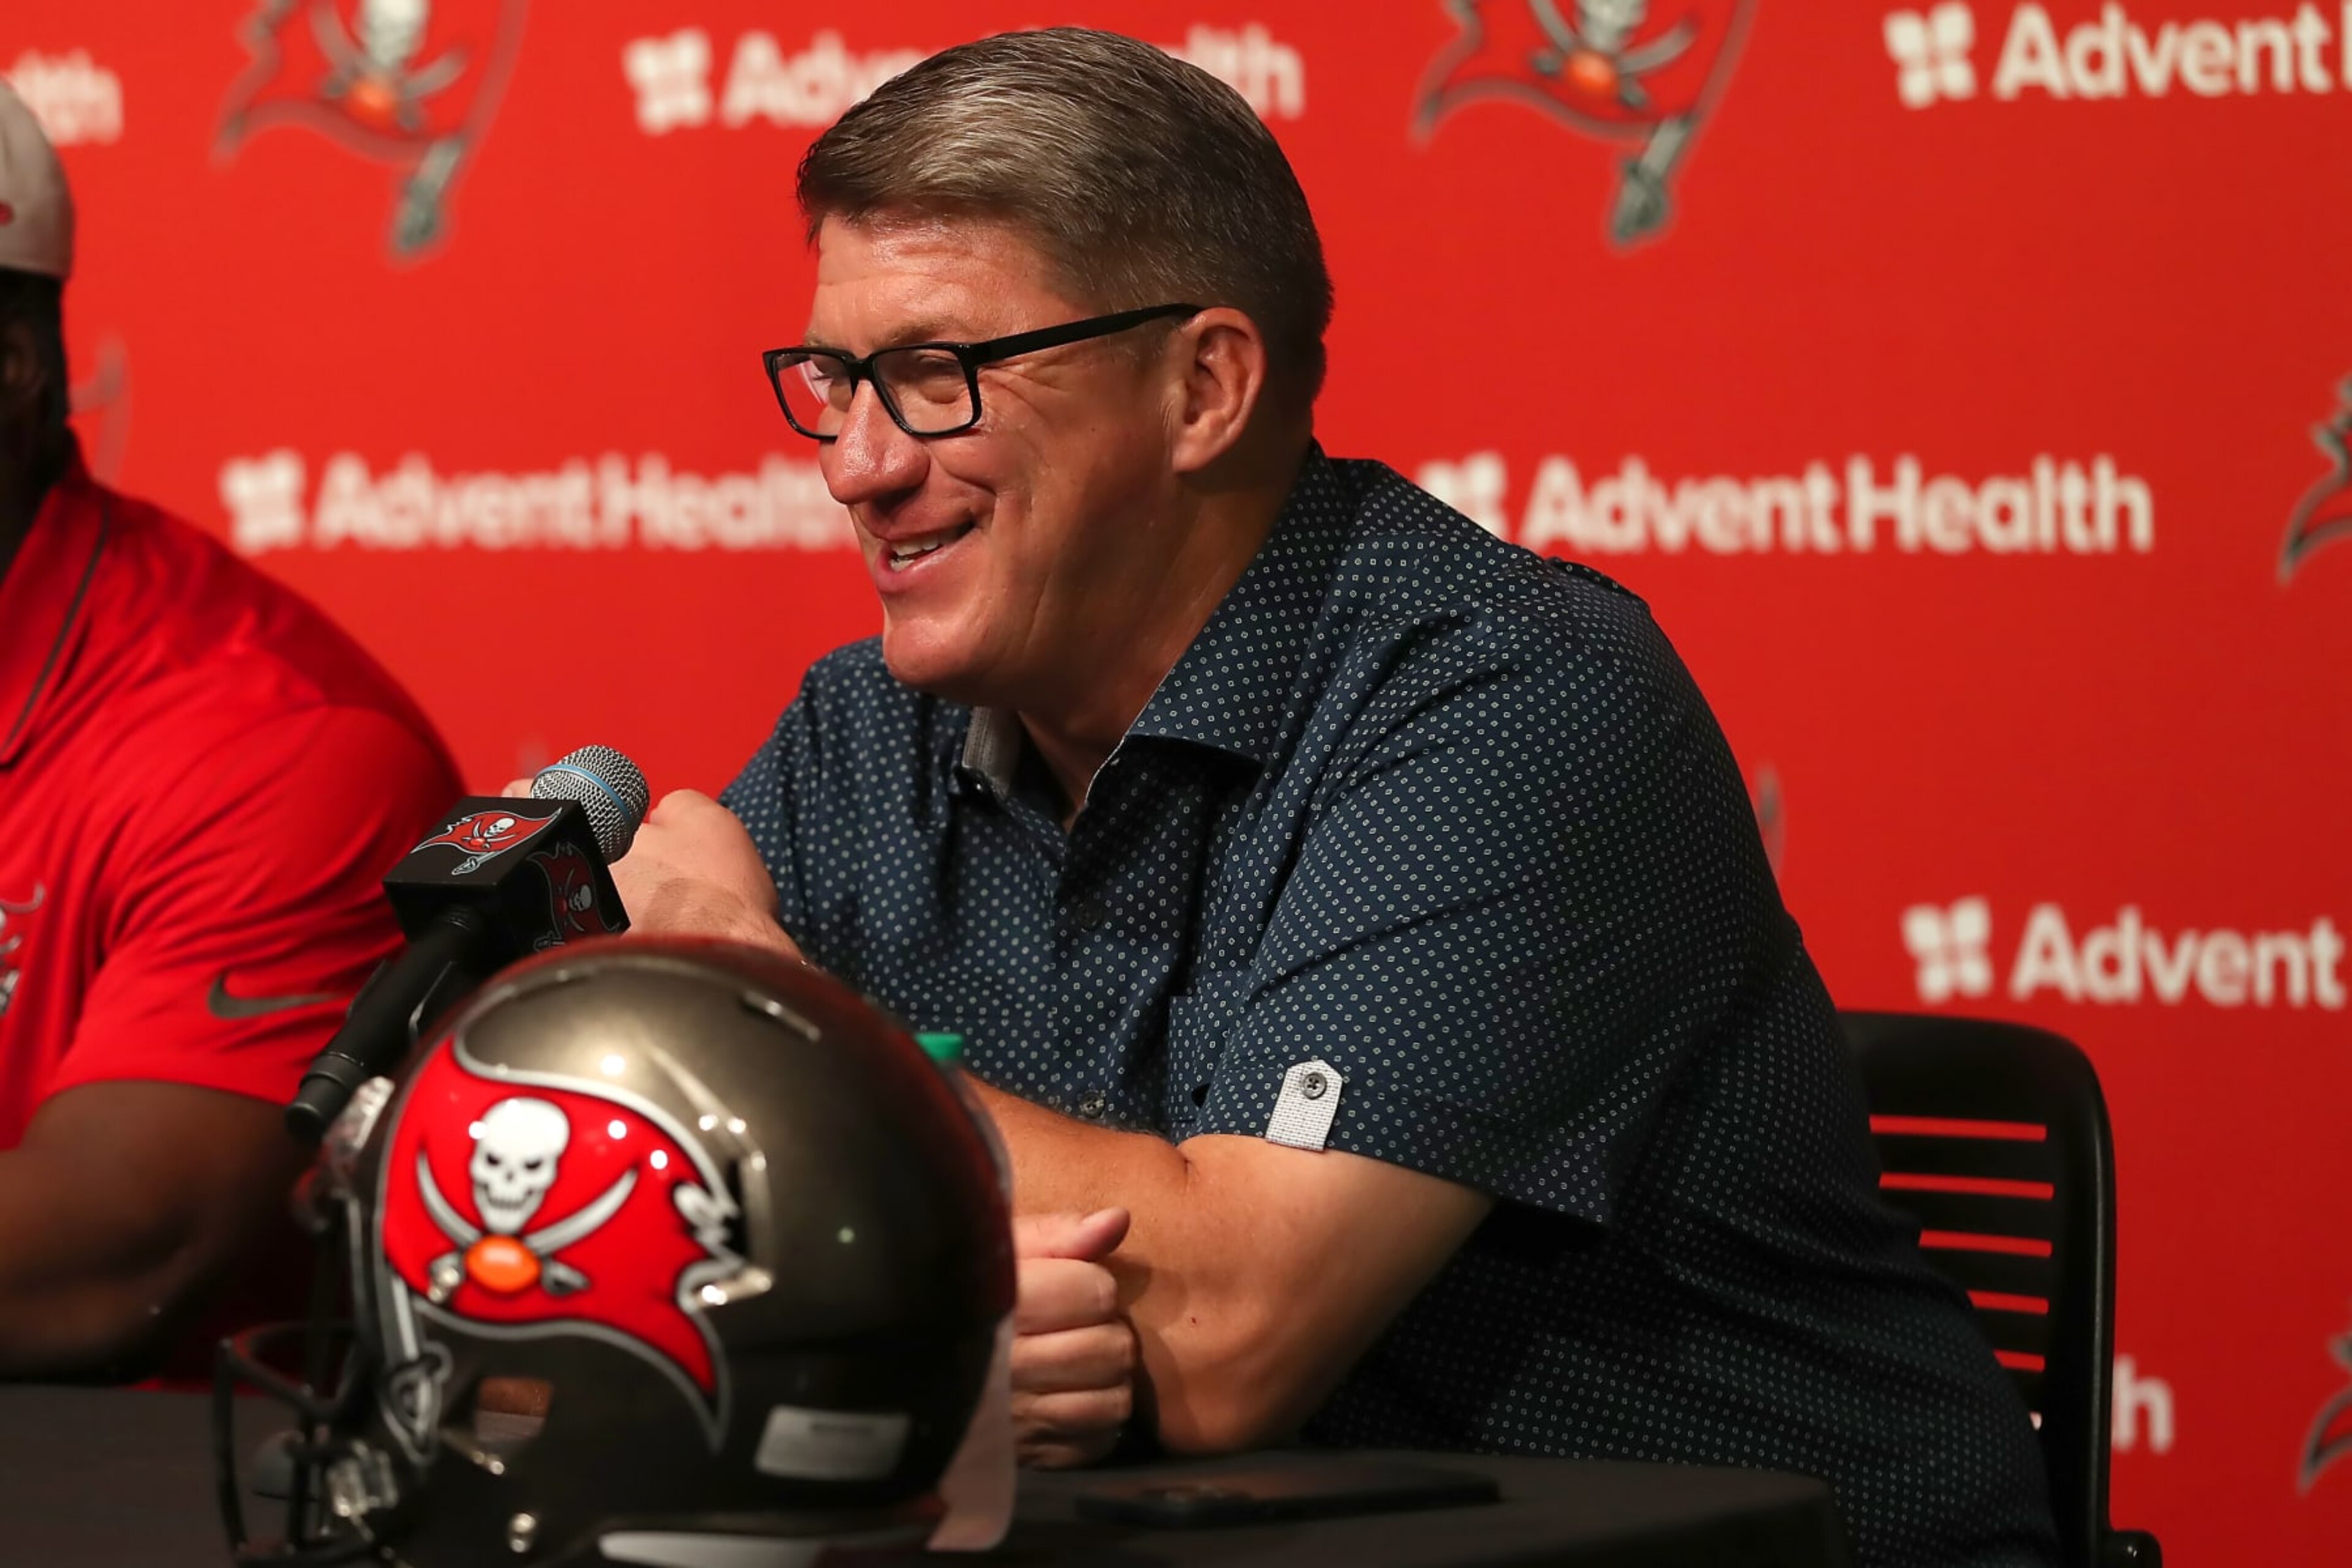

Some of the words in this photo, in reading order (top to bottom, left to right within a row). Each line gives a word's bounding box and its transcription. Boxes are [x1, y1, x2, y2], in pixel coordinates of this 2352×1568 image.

[1992, 0, 2352, 100] Advent
[1521, 454, 2154, 553] AdventHealth
[2009, 903, 2346, 1009] Advent
